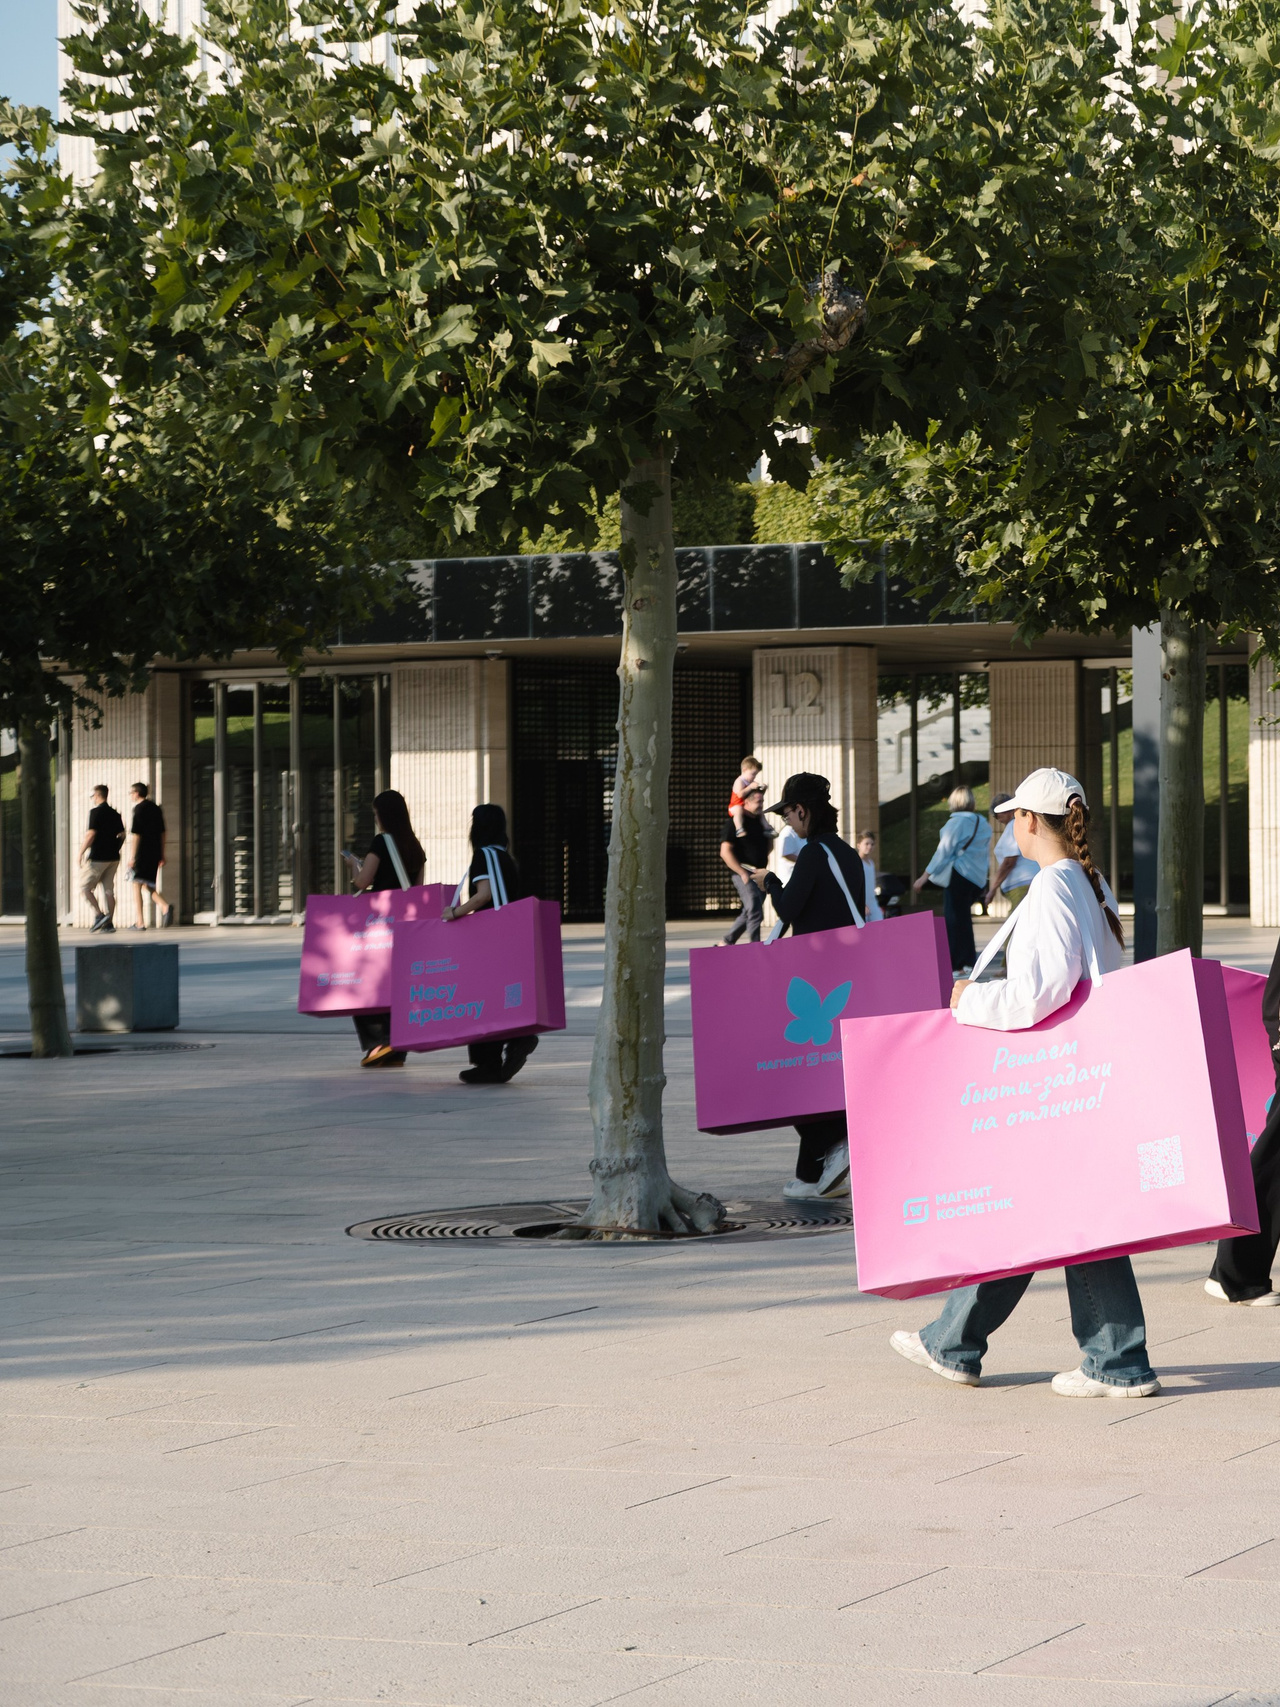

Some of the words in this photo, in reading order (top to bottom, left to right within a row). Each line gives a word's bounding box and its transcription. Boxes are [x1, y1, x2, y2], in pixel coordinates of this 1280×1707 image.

[770, 671, 824, 717] 12
[410, 983, 458, 1003] Несу
[408, 1000, 485, 1027] красоту
[757, 1055, 805, 1071] МАГНИТ
[993, 1040, 1078, 1074] Решаем
[960, 1062, 1112, 1106] бьюти-задачи
[971, 1115, 999, 1134] на
[1006, 1081, 1106, 1126] отлично!
[935, 1185, 993, 1205] МАГНИТ
[936, 1197, 1014, 1221] КОСМЕТИК
